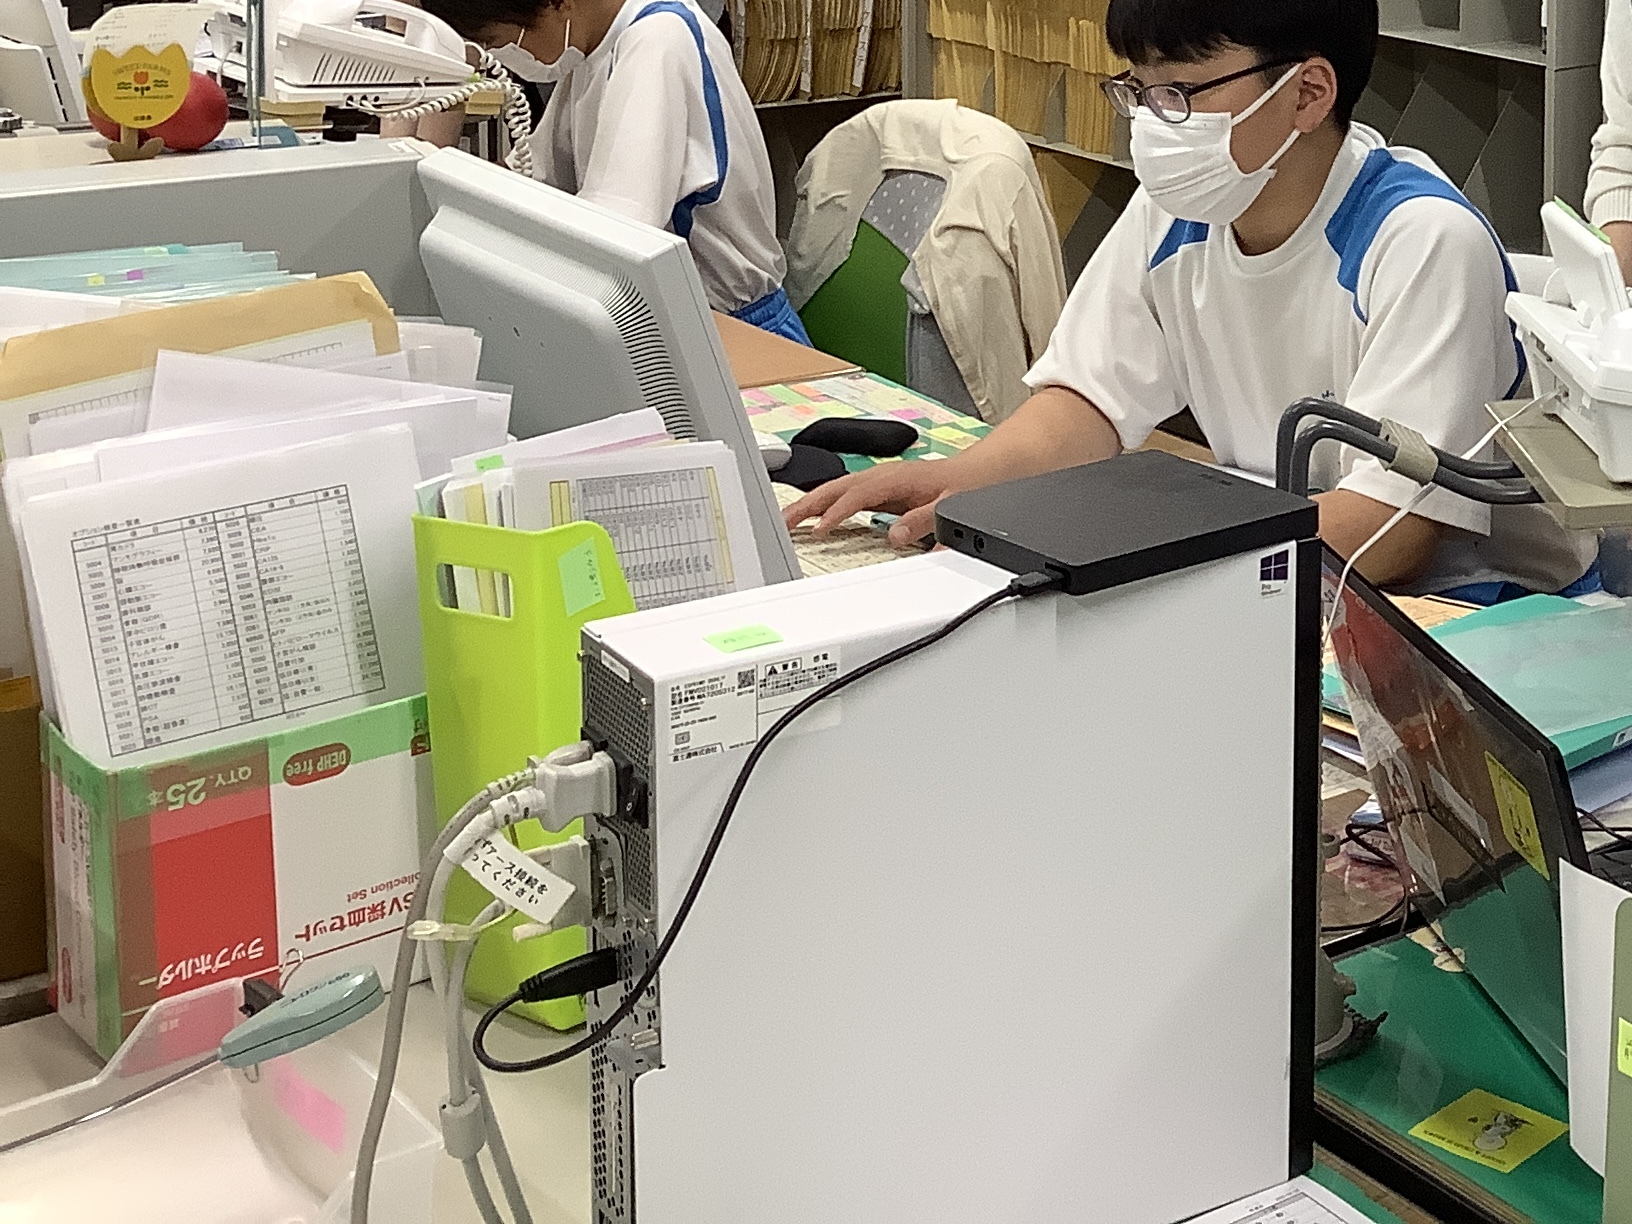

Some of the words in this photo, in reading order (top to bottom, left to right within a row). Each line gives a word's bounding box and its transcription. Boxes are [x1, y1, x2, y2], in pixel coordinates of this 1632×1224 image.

[286, 759, 310, 777] free
[311, 749, 347, 772] DEHP
[478, 837, 549, 895] ずアース接続を
[370, 871, 422, 895] ollection
[472, 853, 539, 905] ってください
[346, 887, 367, 903] Set
[138, 937, 265, 989] ラップホルダー
